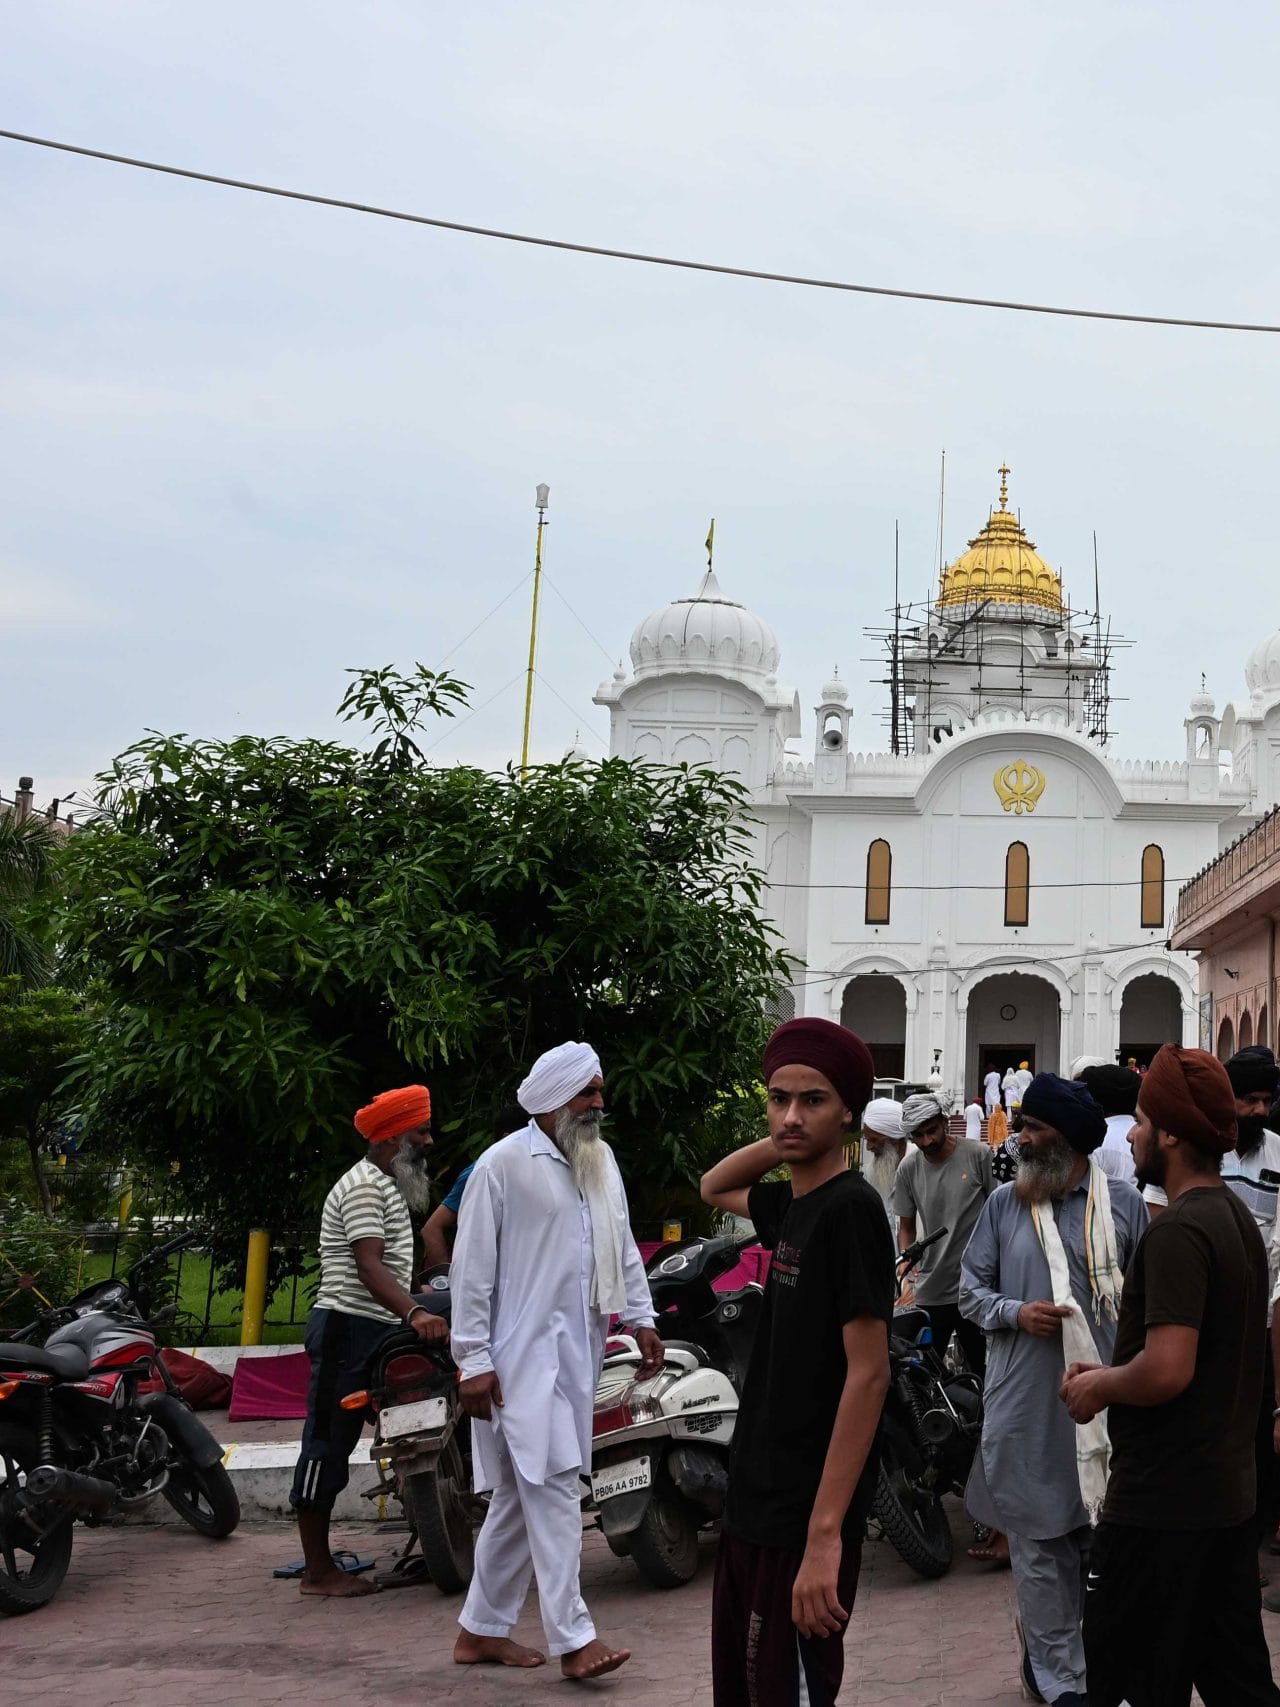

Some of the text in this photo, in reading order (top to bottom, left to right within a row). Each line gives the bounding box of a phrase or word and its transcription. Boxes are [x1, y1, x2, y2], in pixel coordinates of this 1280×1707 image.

[595, 1474, 648, 1498] PB06 AA 9782
